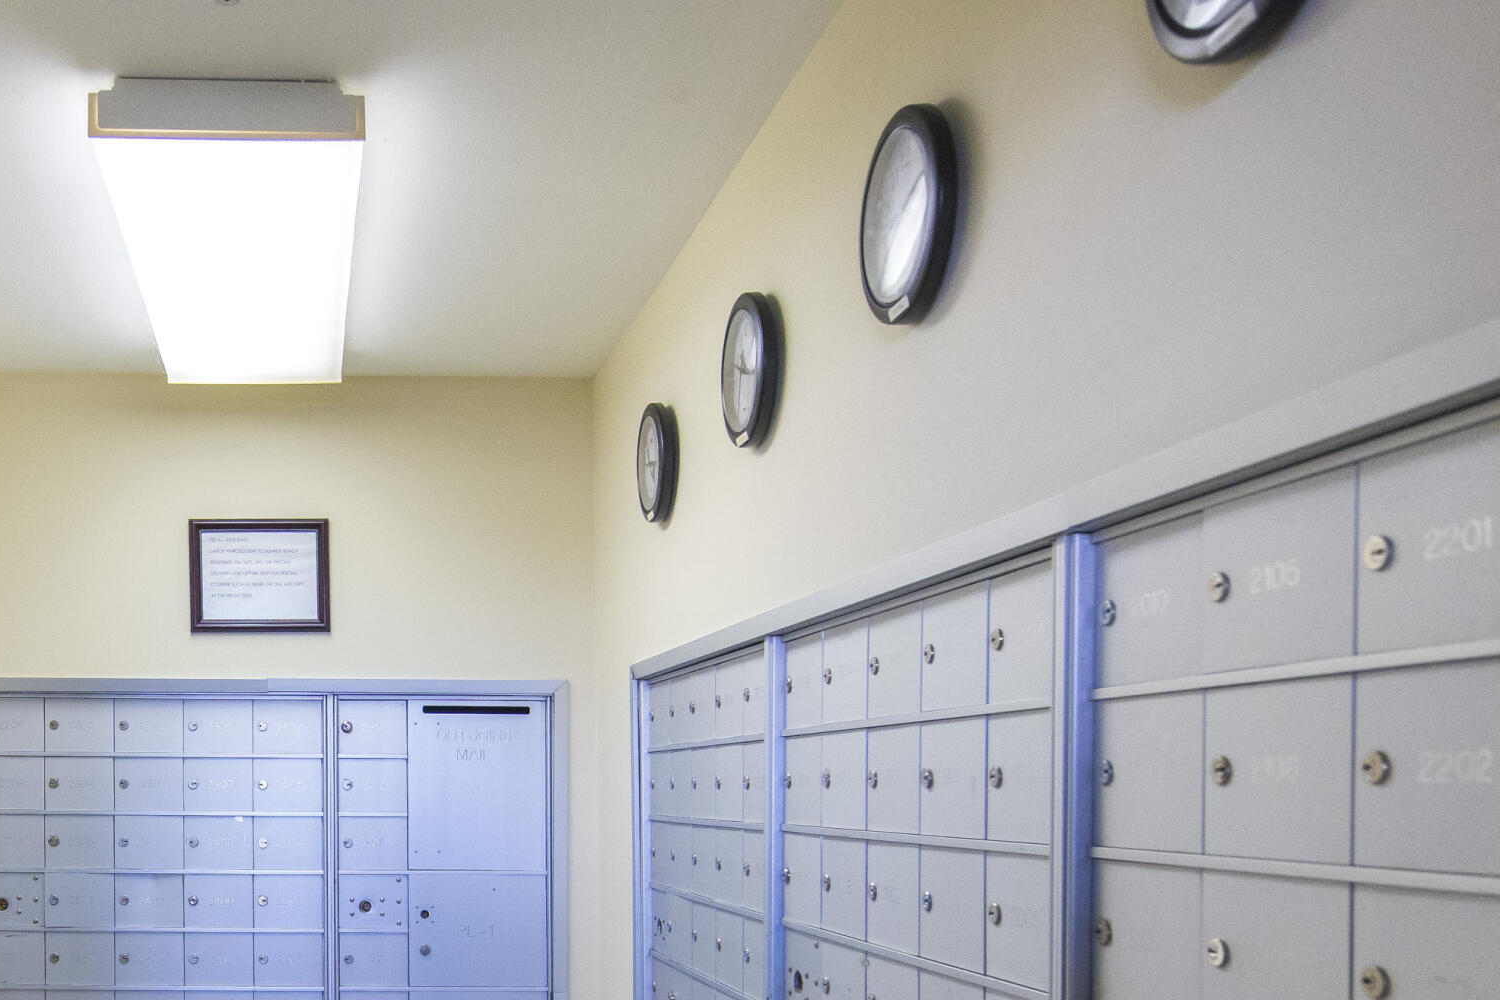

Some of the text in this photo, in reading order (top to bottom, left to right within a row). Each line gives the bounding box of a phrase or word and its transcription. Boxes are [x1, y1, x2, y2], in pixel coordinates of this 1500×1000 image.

[1423, 516, 1494, 561] 2201
[1248, 558, 1301, 595] 2105
[436, 728, 513, 744] OUTGOING
